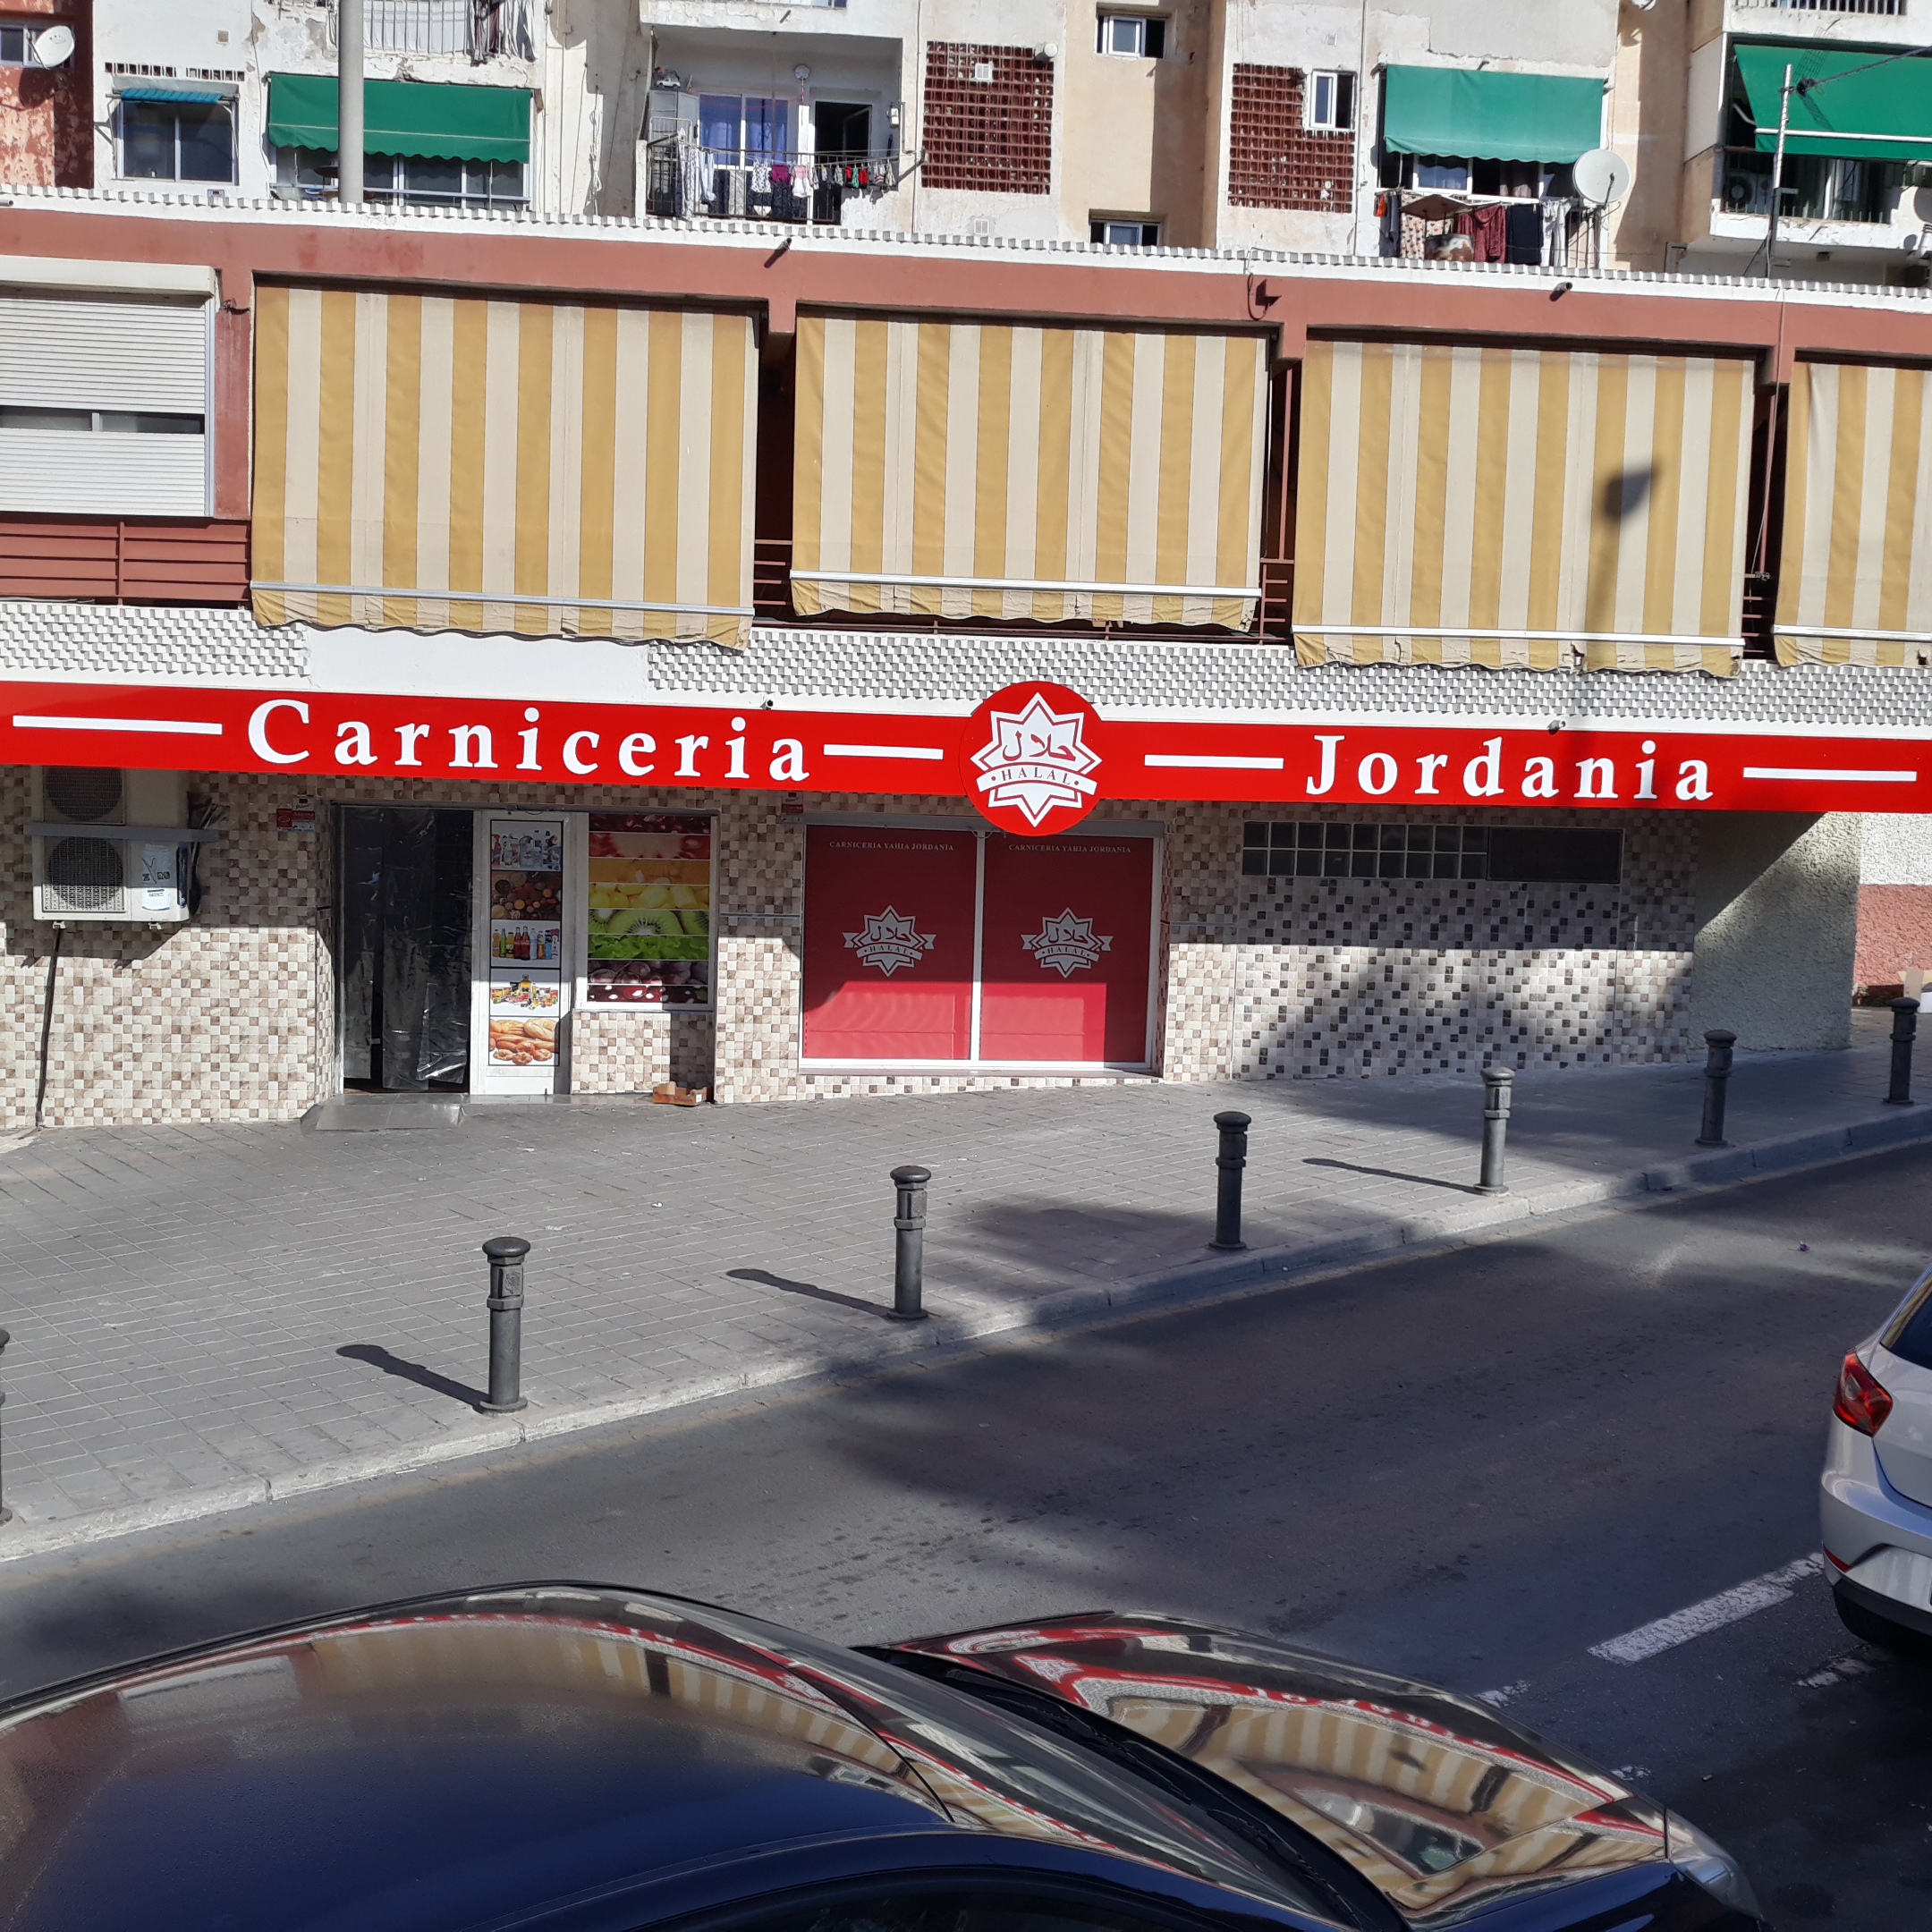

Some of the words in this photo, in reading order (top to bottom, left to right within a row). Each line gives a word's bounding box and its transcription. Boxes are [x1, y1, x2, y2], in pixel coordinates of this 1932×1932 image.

[247, 699, 810, 783] Carniceria
[1305, 734, 1714, 801] Jordania
[1002, 730, 1077, 762] حلال
[1001, 767, 1072, 785] HALAL
[829, 841, 882, 849] CARNICERIA
[911, 843, 954, 851] JORDANIA
[1089, 845, 1131, 853] JORDANIA
[869, 925, 911, 943] حلال
[1047, 927, 1089, 945] حلال
[869, 945, 908, 954] HALAL
[1047, 946, 1086, 956] HALAL
